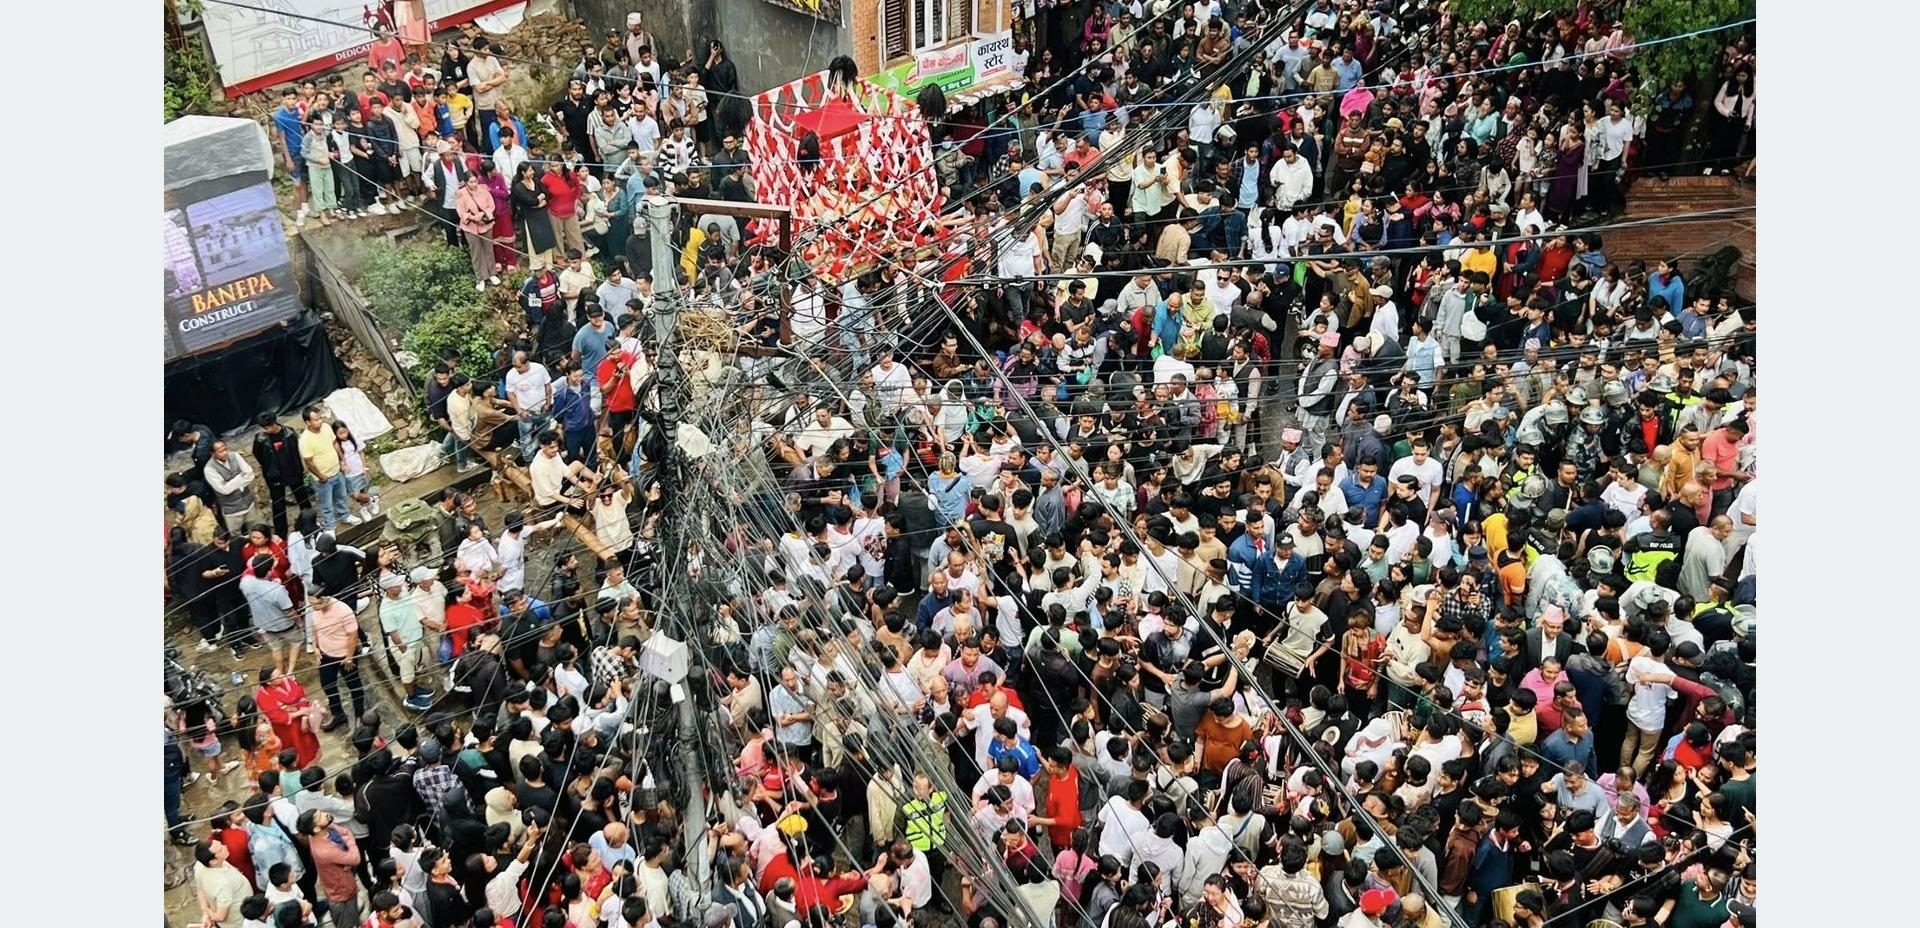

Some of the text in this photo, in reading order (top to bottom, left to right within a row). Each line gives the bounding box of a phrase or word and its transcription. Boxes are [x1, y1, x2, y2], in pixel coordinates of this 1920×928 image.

[977, 37, 1010, 56] कायस्थ
[984, 54, 1004, 69] स्टोर
[191, 274, 274, 314] BANEPA
